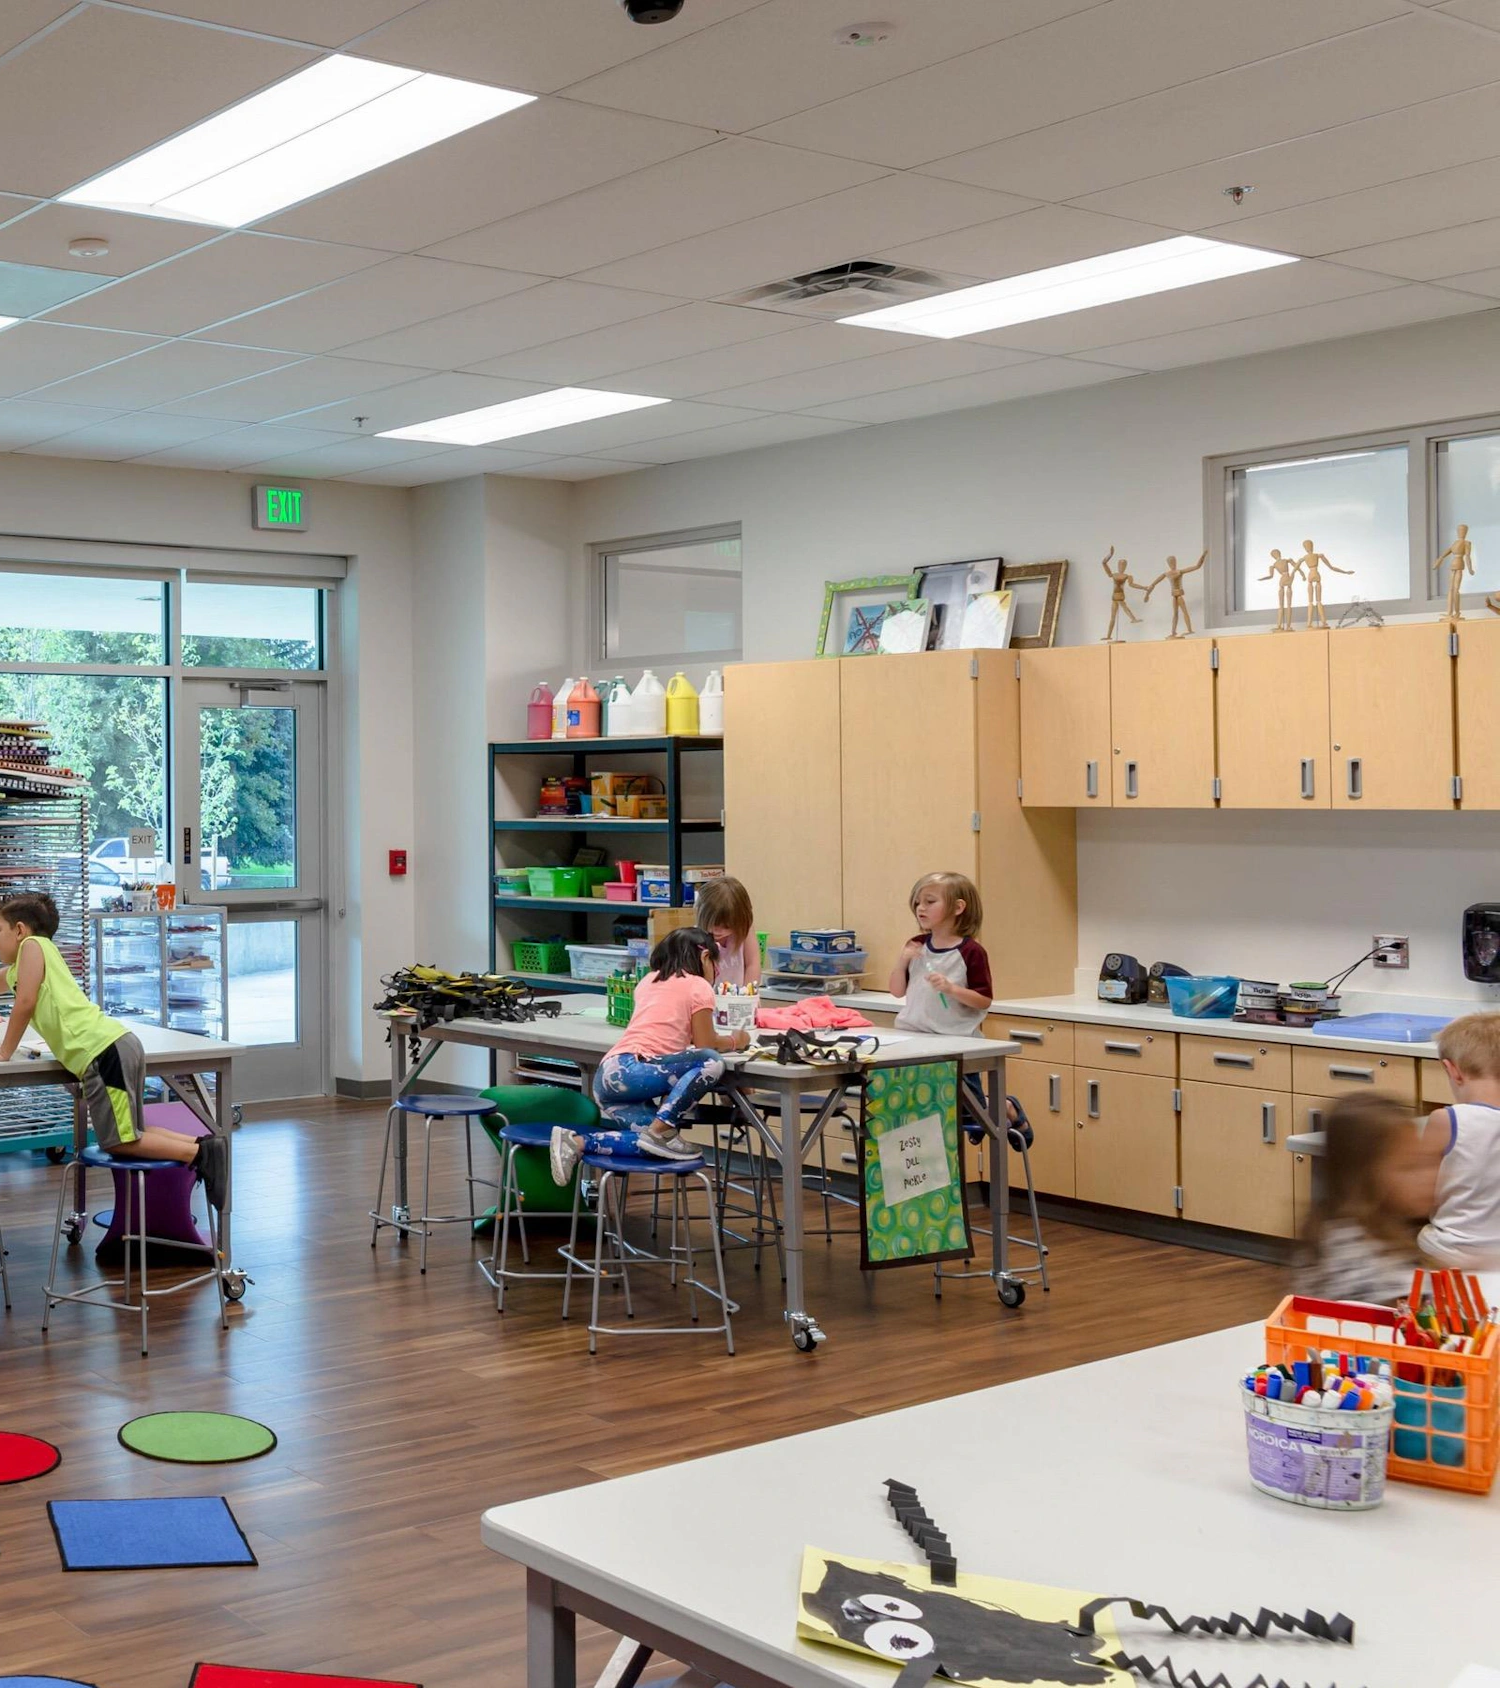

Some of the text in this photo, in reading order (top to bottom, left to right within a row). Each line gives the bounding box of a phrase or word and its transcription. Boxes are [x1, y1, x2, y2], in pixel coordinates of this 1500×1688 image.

[267, 489, 302, 524] EXIT
[131, 834, 153, 845] EXIT
[1248, 1427, 1299, 1452] NORDICA
